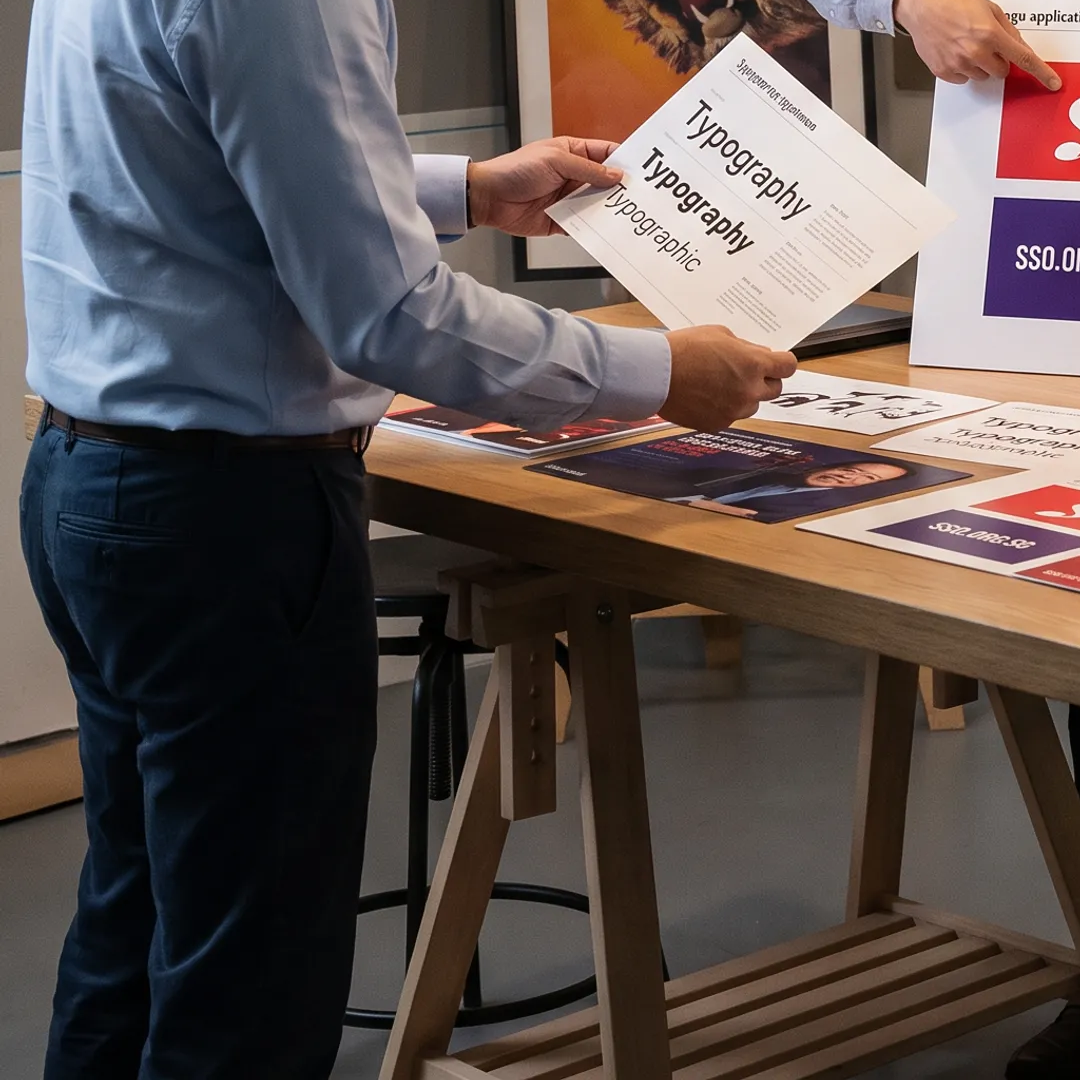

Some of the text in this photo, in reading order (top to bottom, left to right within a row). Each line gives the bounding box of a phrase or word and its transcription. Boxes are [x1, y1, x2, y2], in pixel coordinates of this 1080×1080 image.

[642, 146, 755, 255] Typography
[686, 99, 812, 221] Typography
[604, 182, 701, 272] Typographic
